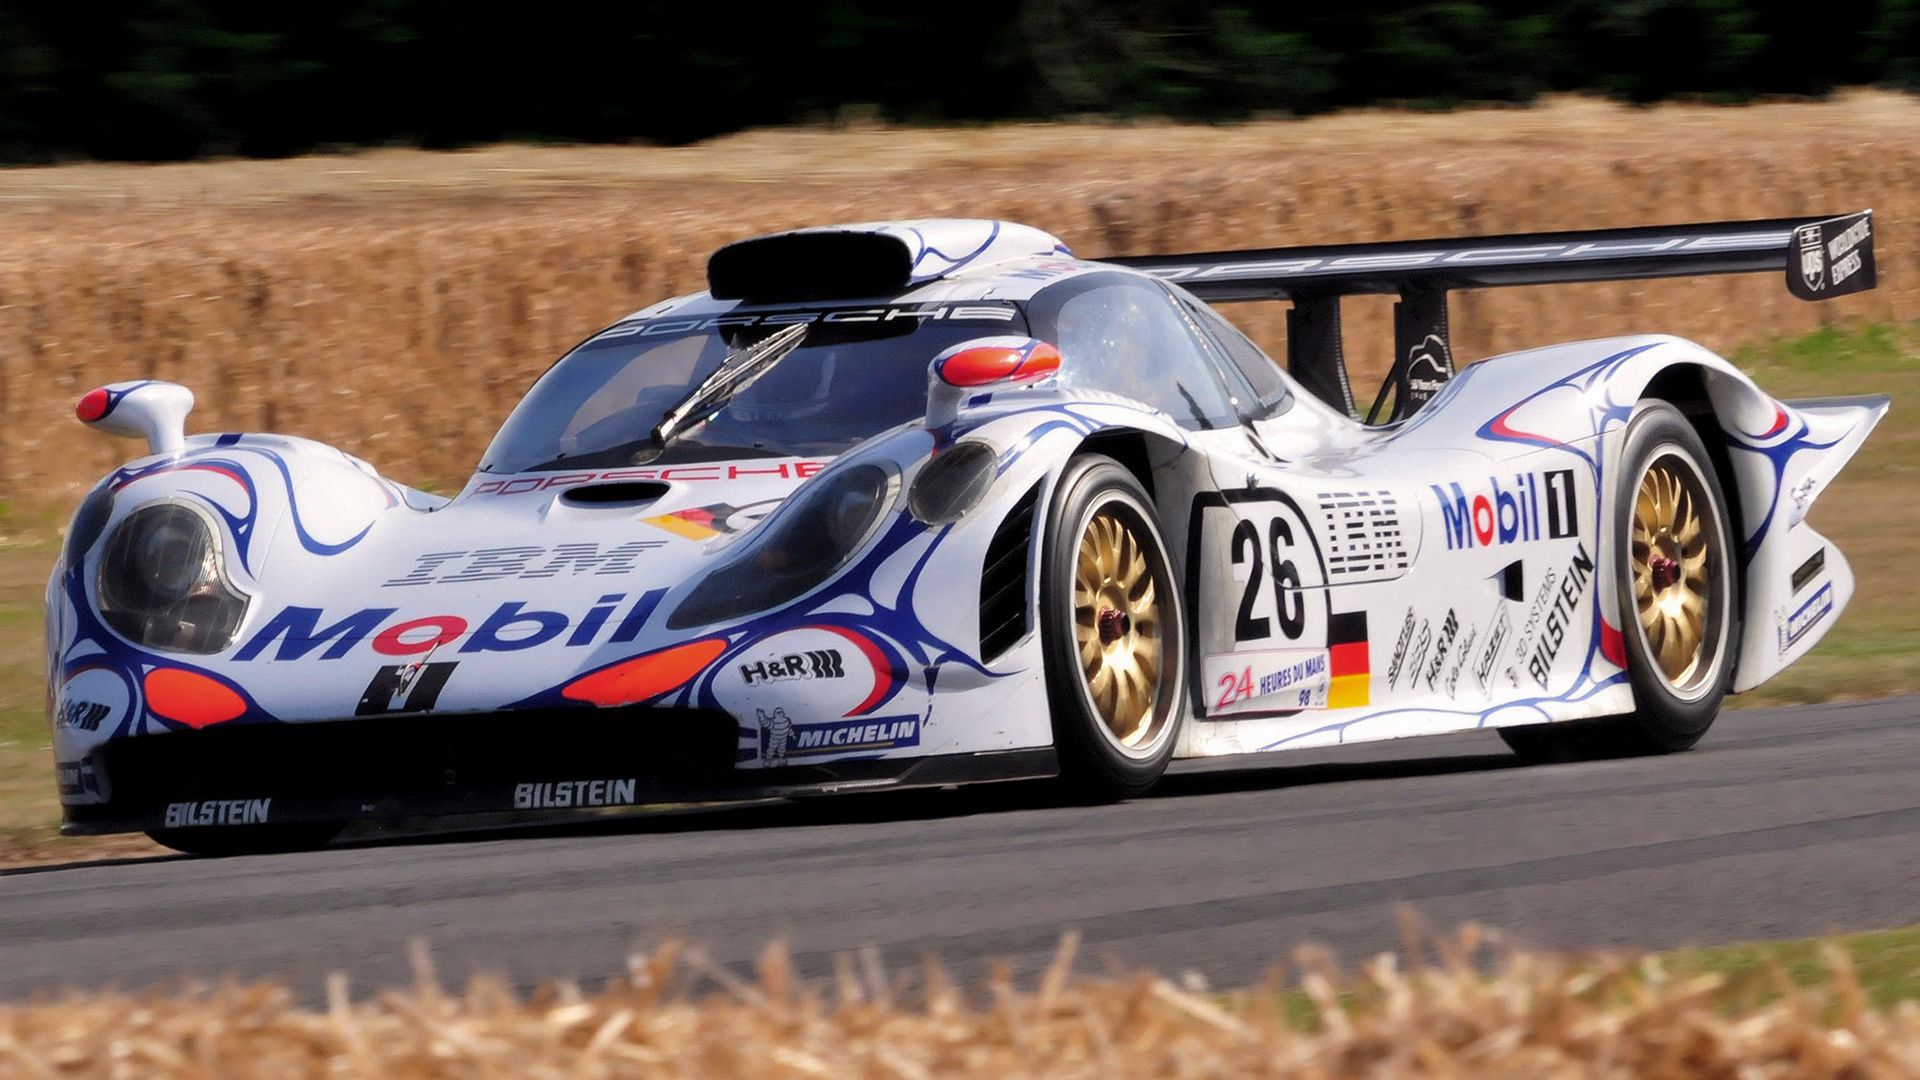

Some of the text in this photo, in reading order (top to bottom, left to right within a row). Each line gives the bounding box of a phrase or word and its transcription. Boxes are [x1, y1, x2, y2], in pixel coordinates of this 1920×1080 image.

[592, 306, 1016, 339] PORSCHE
[1317, 490, 1408, 574] IBM
[1430, 472, 1540, 550] Mobil
[381, 541, 668, 588] IBM
[1231, 516, 1305, 640] 26
[230, 587, 670, 662] Mobil
[1529, 541, 1594, 692] BILSTEIN
[740, 654, 807, 683] H&R
[1216, 654, 1325, 710] 24 HEURES DU MANS
[1299, 689, 1311, 706] 98
[797, 720, 917, 748] MICHELIN
[164, 798, 271, 829] BILSTEIN
[514, 779, 636, 809] BILSTEIN
